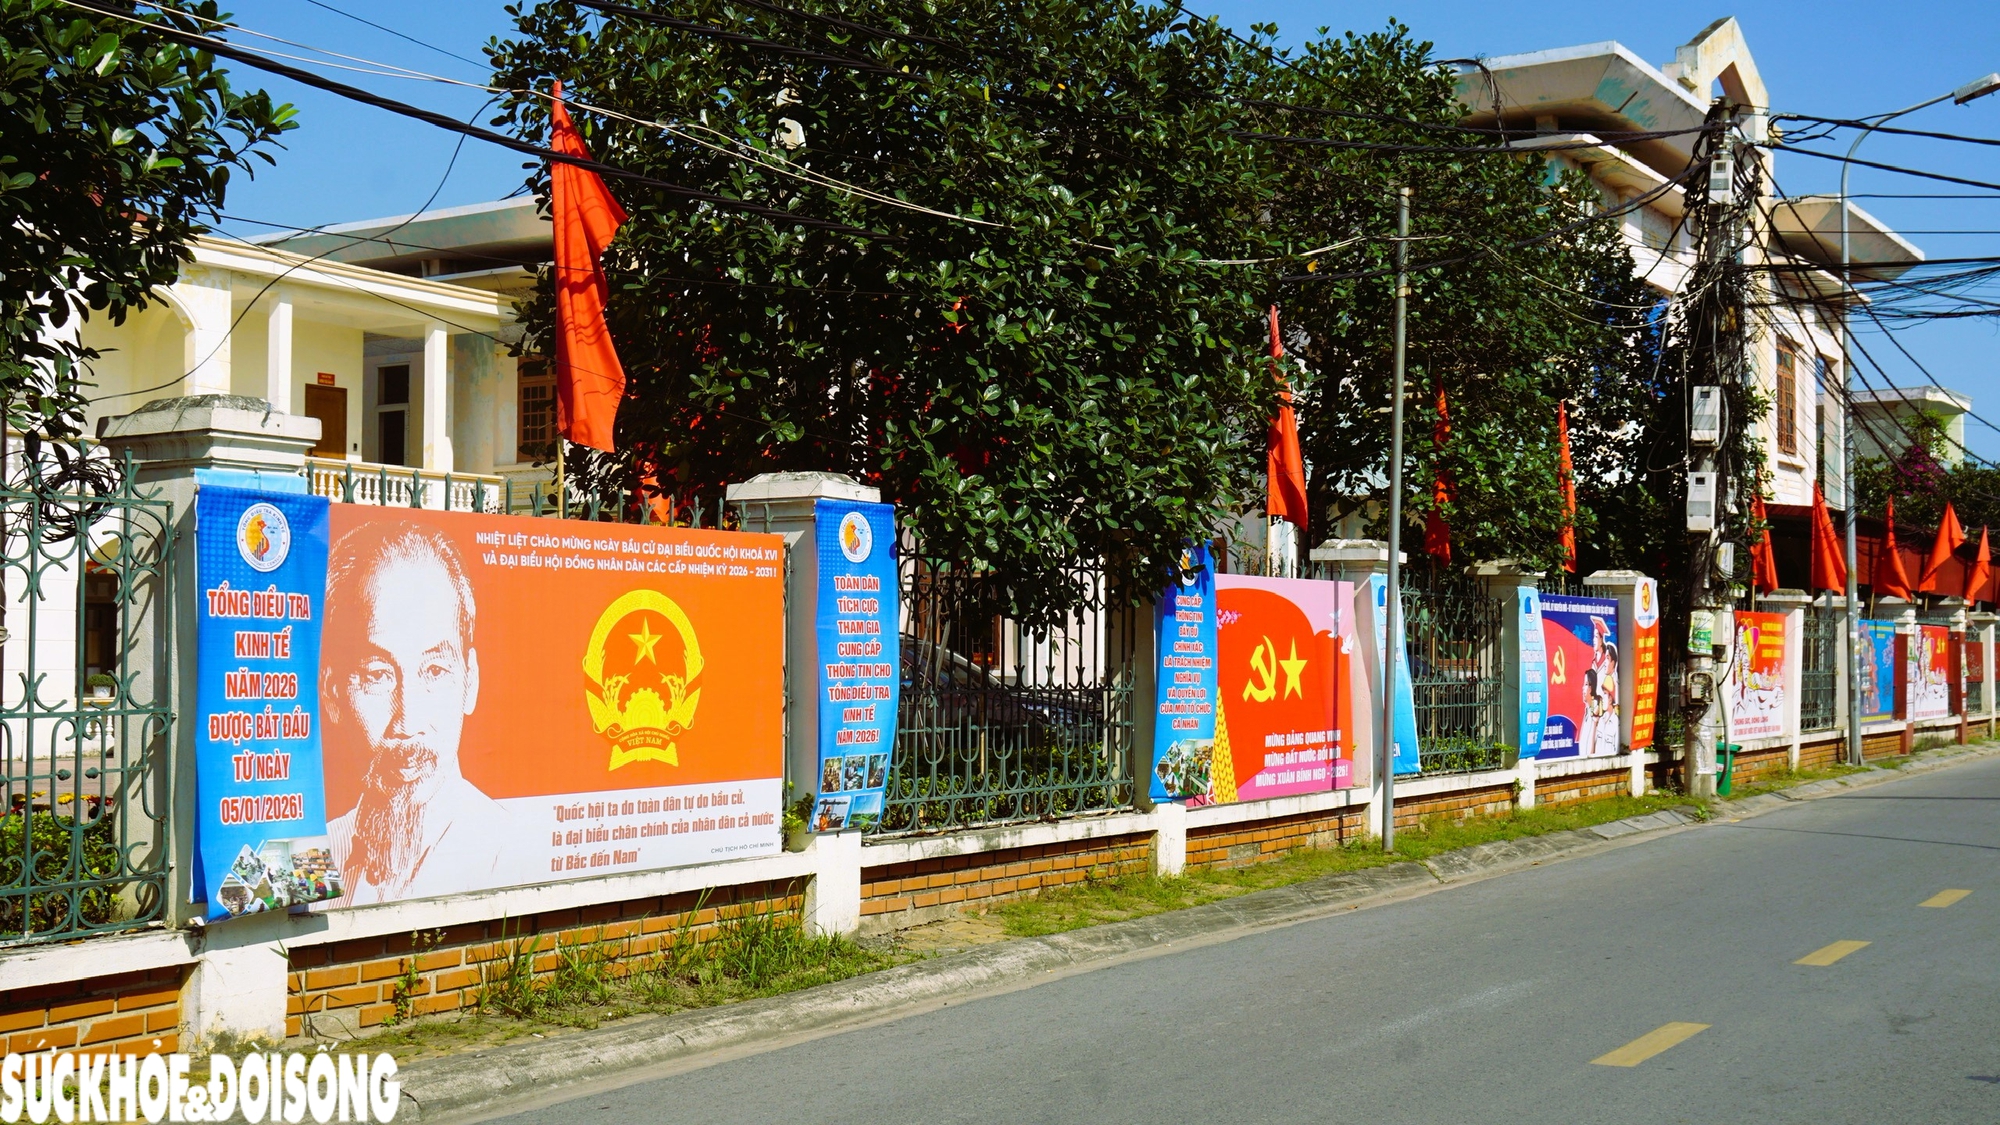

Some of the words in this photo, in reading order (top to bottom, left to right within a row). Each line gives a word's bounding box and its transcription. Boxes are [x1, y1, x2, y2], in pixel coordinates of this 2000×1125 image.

[476, 531, 506, 548] NHIỆT
[508, 532, 528, 549] LIỆT
[530, 534, 560, 548] CHÀO
[562, 536, 591, 550] MỪNG
[594, 538, 620, 552] NGÀY
[622, 538, 640, 554] BẦU
[642, 540, 656, 555] CỬ
[657, 543, 672, 558] ĐẠI
[675, 541, 694, 557] BIỂU
[696, 543, 722, 558] QUỐC
[723, 545, 738, 562] HỘI
[740, 545, 763, 560] KHOÁ
[764, 550, 778, 561] XVI
[482, 550, 497, 566] VÀ
[500, 554, 518, 569] ĐẠI
[520, 550, 542, 568] BIỂU
[544, 554, 562, 571] HỘI
[565, 554, 594, 570] ĐỒNG
[597, 558, 623, 571] NHÂN
[625, 559, 644, 572] DÂN
[646, 560, 666, 574] CÁC
[668, 560, 686, 574] CẤP
[688, 562, 714, 578] NHIỆM
[716, 562, 728, 576] KỲ
[728, 566, 748, 577] 2026
[834, 574, 860, 591] TOÀN
[862, 574, 880, 591] DÂN
[207, 580, 250, 618] TỔNG
[253, 584, 285, 619] ĐIỀU
[288, 593, 310, 620] TRA
[838, 596, 860, 612] TÍCH
[861, 598, 879, 616] CỰC
[838, 620, 866, 634] THAM
[866, 621, 880, 634] GIA
[235, 631, 269, 658] KINH
[272, 625, 292, 658] TẾ
[838, 642, 862, 656] CUNG
[864, 638, 882, 656] CẤP
[826, 661, 856, 678] THÔNG
[858, 664, 872, 678] TIN
[873, 664, 892, 677] CHO
[1164, 655, 1173, 668] LÀ
[1174, 655, 1192, 668] TRÁCH
[1192, 656, 1212, 670] NHIỆM
[225, 667, 262, 699] NĂM
[263, 672, 297, 699] 2026
[828, 682, 851, 701] TỔNG
[852, 682, 872, 700] ĐIỀU
[874, 686, 890, 700] TRA
[844, 708, 862, 722] KINH
[864, 704, 876, 721] TẾ
[208, 711, 252, 745] ĐƯỢC
[255, 705, 280, 740] BẮT
[282, 705, 310, 739] ĐẦU
[1172, 718, 1181, 730] CÁ
[1182, 717, 1199, 730] NHÂN
[627, 736, 644, 746] VIỆT
[646, 736, 662, 746] NAM
[837, 728, 854, 744] NĂM
[856, 729, 879, 743] 2026!
[1265, 732, 1284, 748] MỪNG
[1286, 730, 1304, 746] ĐẢNG
[1305, 731, 1326, 745] QUANG
[1327, 730, 1341, 742] VINH
[233, 749, 255, 782] TỪ
[256, 749, 290, 781] NGÀY
[1264, 751, 1284, 768] MỪNG
[1286, 748, 1298, 764] ĐẤT
[1299, 748, 1316, 763] NƯỚC
[1318, 744, 1328, 760] ĐỔI
[1256, 772, 1276, 787] MỪNG
[1277, 769, 1295, 784] XUÂN
[1296, 768, 1312, 782] BÍNH
[1312, 767, 1326, 782] NGỌ
[220, 793, 304, 825] 05/01/2026!
[588, 801, 605, 822] hội
[607, 802, 618, 817] ta
[621, 800, 634, 816] do
[637, 797, 660, 814] toàn
[663, 796, 681, 812] dân
[684, 796, 695, 813] tự
[697, 794, 709, 808] do
[712, 791, 729, 807] bầu
[552, 831, 562, 847] là
[566, 830, 582, 848] đại
[586, 824, 609, 843] biểu
[612, 826, 638, 841] chân
[640, 822, 668, 838] chính
[671, 818, 690, 835] của
[692, 816, 716, 832] nhân
[718, 814, 736, 830] dân
[738, 812, 749, 828] cả
[752, 811, 774, 826] nước
[551, 855, 563, 872] từ
[566, 852, 587, 871] Bắc
[590, 849, 610, 868] đến
